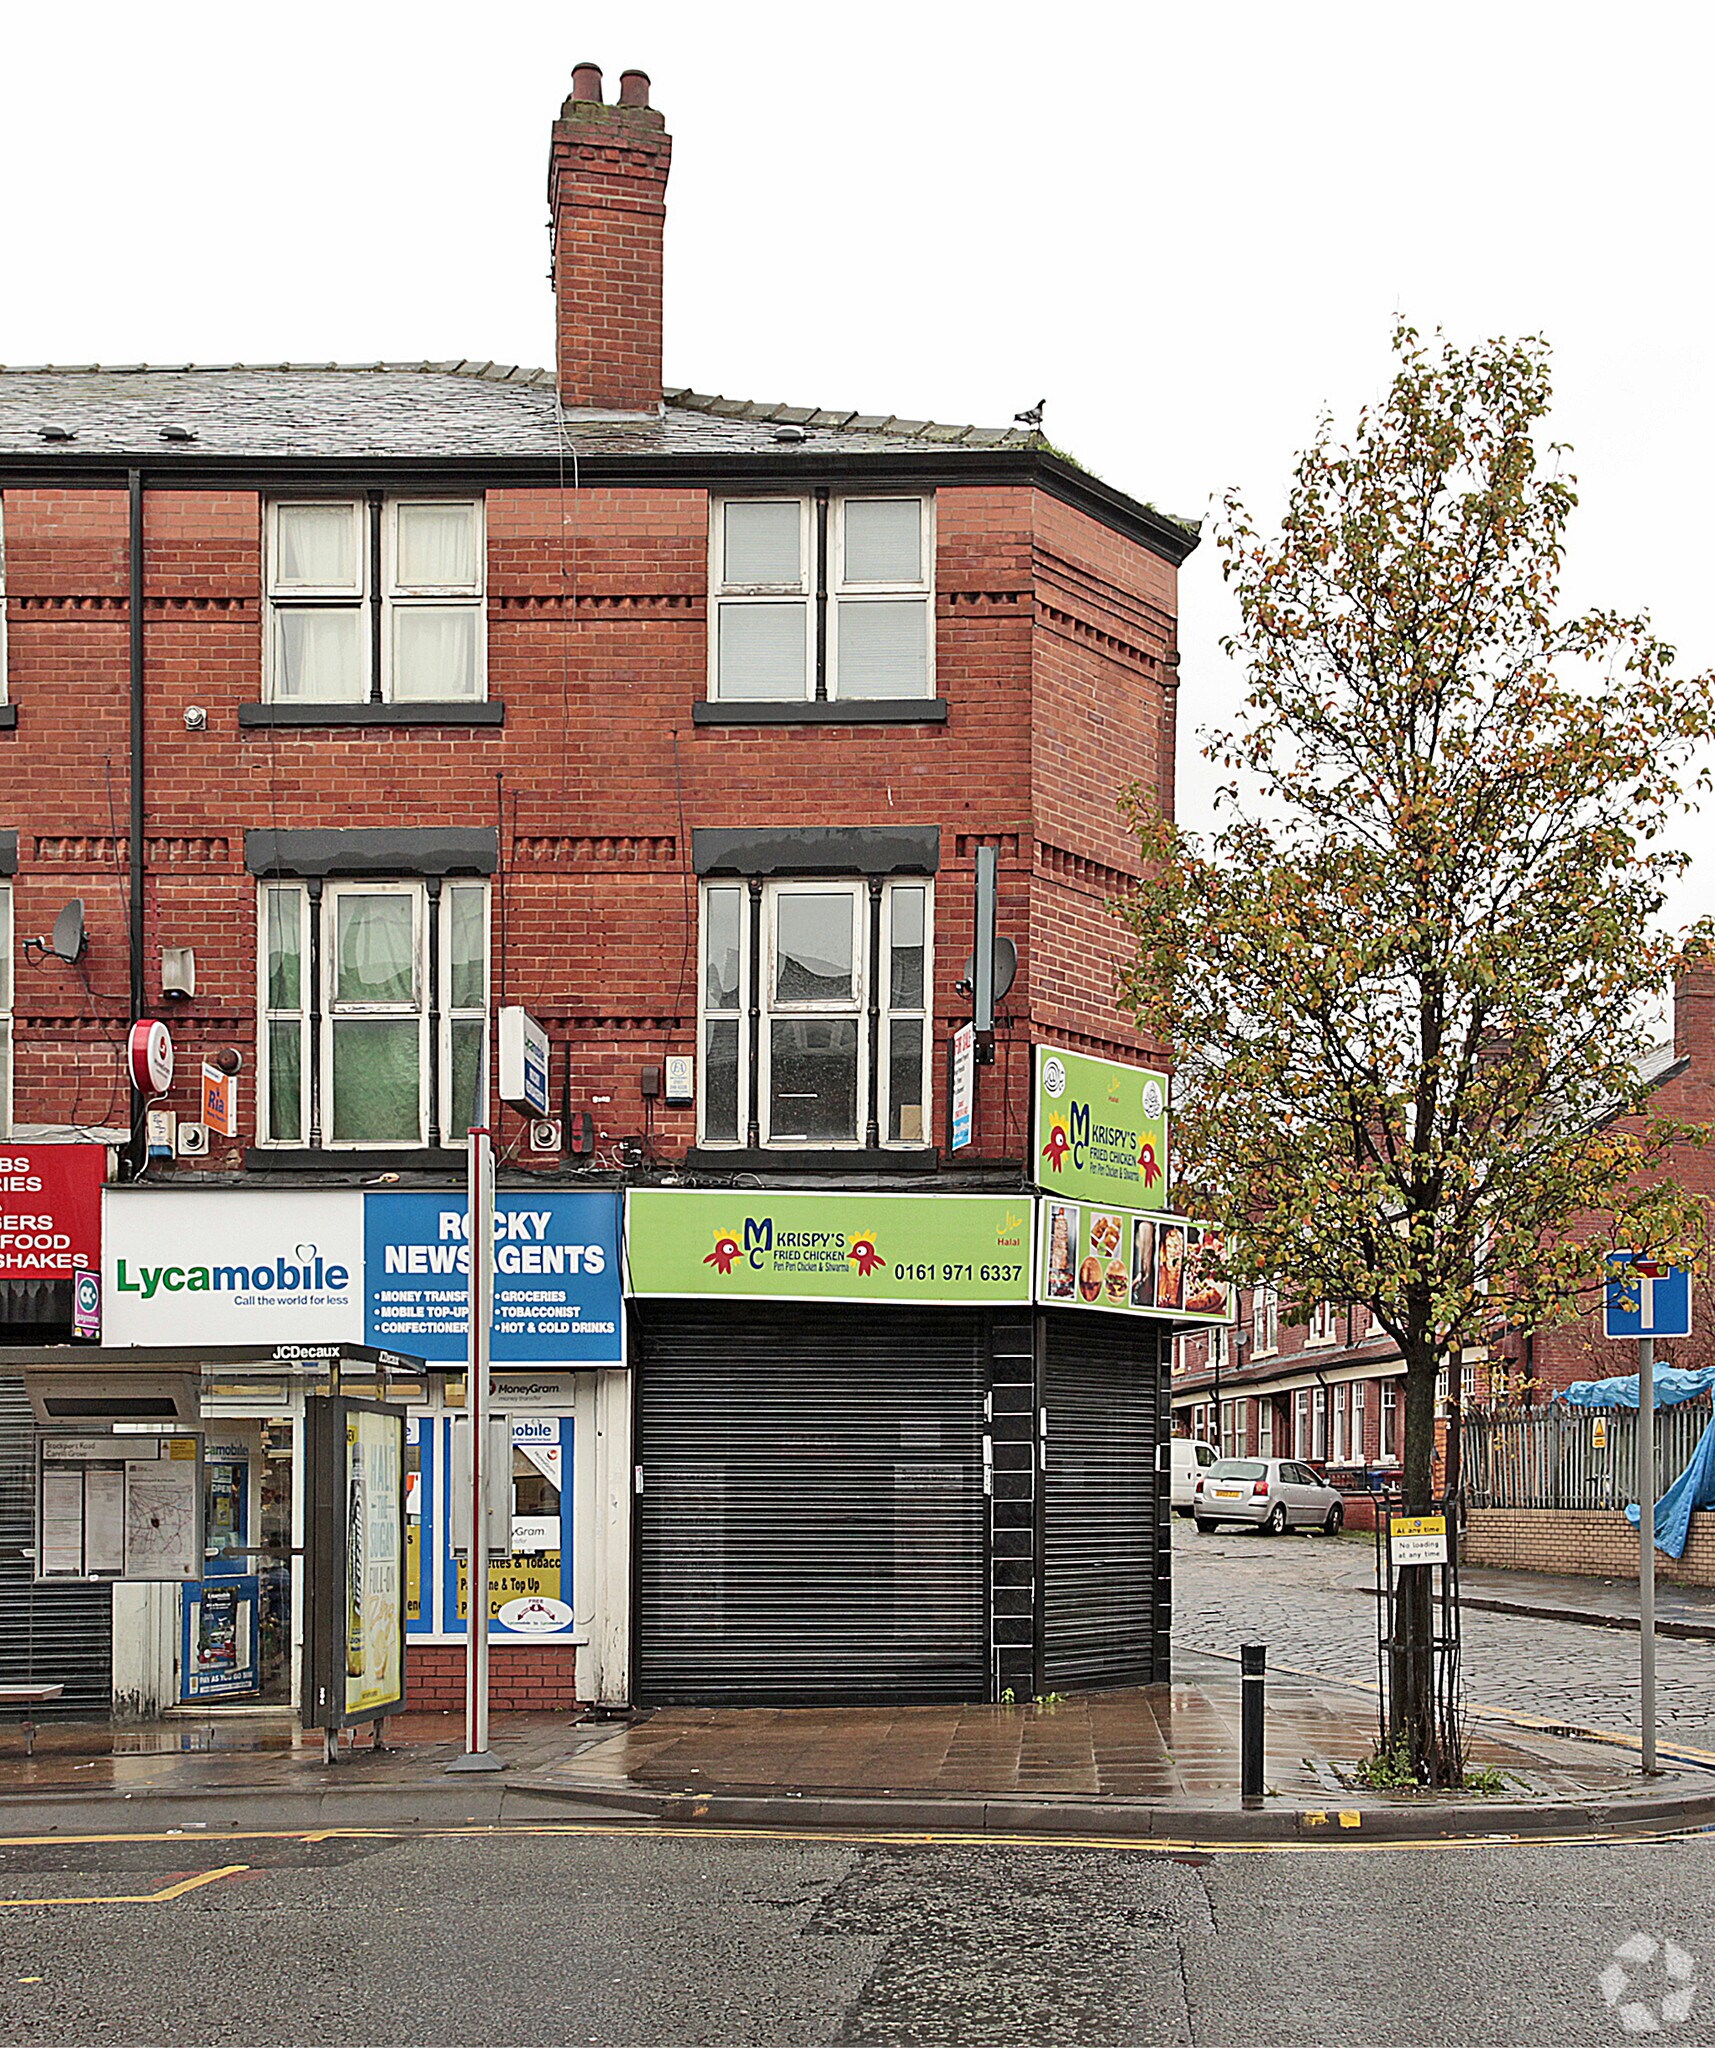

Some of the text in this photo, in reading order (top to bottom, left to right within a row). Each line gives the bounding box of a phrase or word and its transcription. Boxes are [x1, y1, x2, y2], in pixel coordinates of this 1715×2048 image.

[207, 1087, 225, 1114] Ria
[1092, 1124, 1137, 1150] KRISPY'S
[1090, 1147, 1137, 1167] FRIED CHICKEN
[0, 1215, 54, 1231] ERS
[1, 1234, 71, 1250] FOOD
[777, 1232, 846, 1248] KRISPY'S
[997, 1237, 1020, 1246] Halal
[385, 1245, 605, 1275] NEWSGENTS
[773, 1250, 845, 1262] FRIED CHICKEN
[818, 1262, 824, 1272] &
[894, 1263, 1023, 1282] 0161 971 6337
[117, 1255, 349, 1299] Lycamobile
[234, 1295, 349, 1306] Call the world for less
[381, 1291, 469, 1302] MONEY TRANSF
[501, 1291, 566, 1302] GROCERIES
[381, 1306, 426, 1318] MOBILE
[502, 1306, 581, 1318] TOBACCONIST
[381, 1321, 469, 1334] CONFECTIONER
[501, 1322, 615, 1334] HOT & COLD DRINKS
[272, 1346, 341, 1360] JCDecaux
[498, 1384, 559, 1396] MoneyGram
[1412, 1541, 1439, 1549] loading
[501, 1579, 508, 1591] &
[510, 1578, 526, 1593] Top
[528, 1578, 540, 1594] Up
